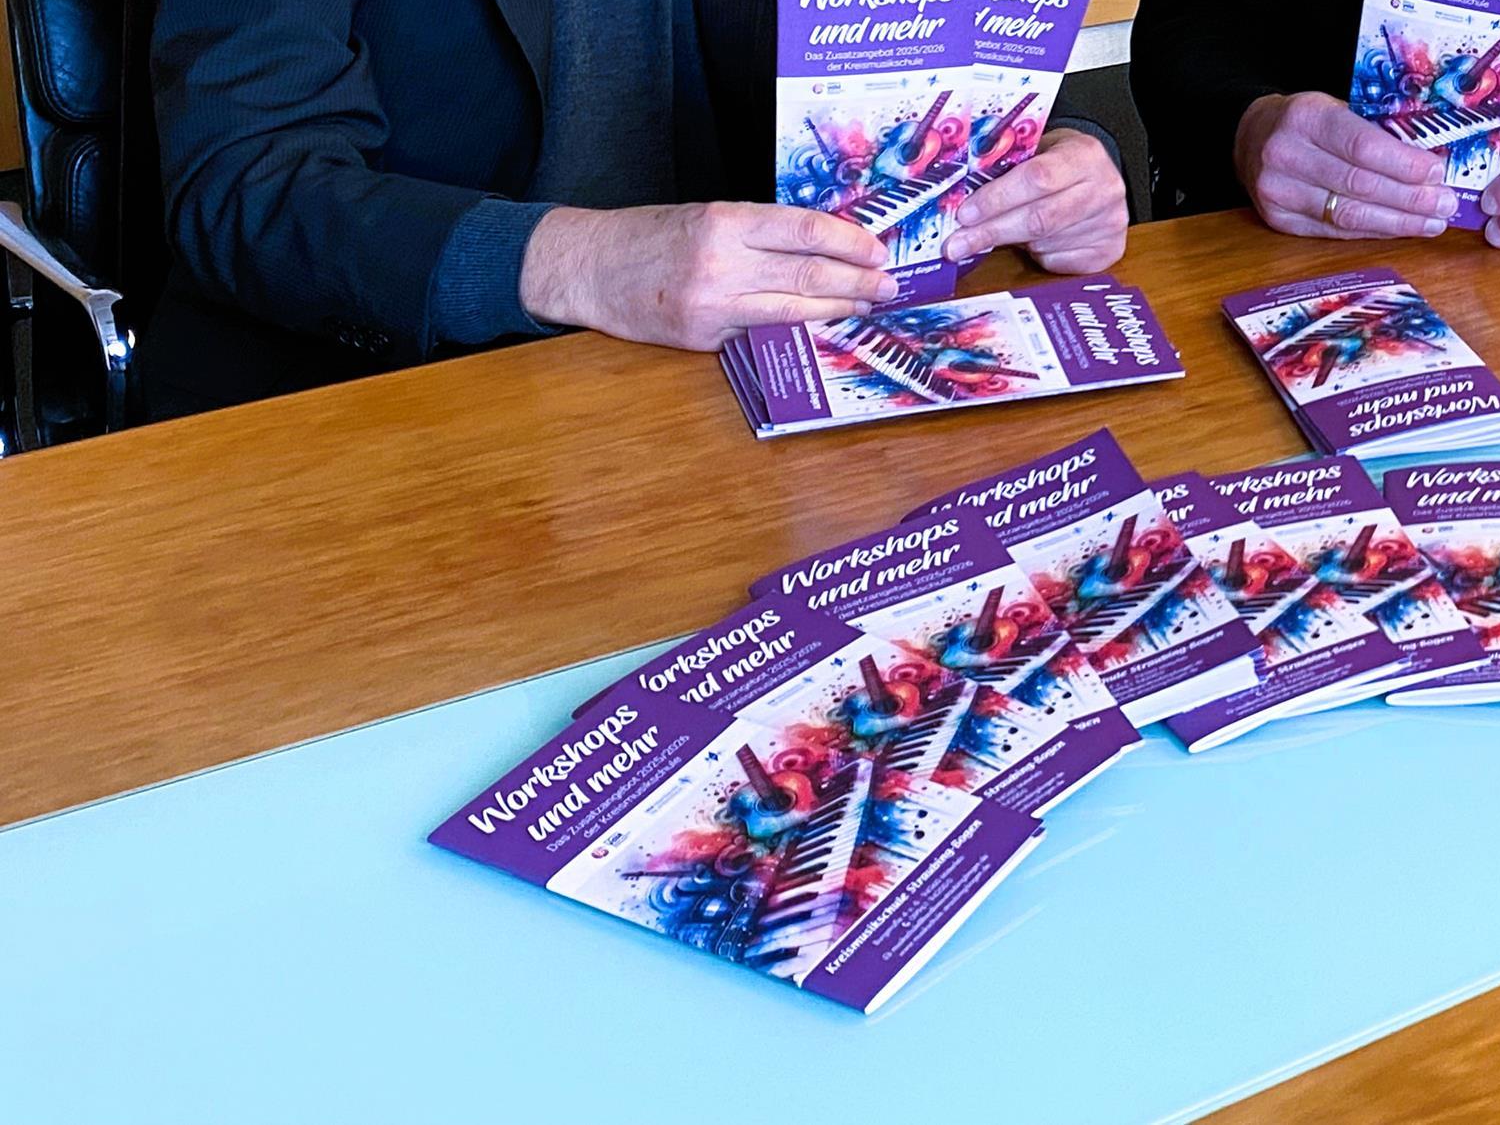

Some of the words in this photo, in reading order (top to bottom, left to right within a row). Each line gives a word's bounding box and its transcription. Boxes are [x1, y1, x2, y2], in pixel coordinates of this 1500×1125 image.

[809, 16, 870, 46] und
[869, 13, 946, 42] mehr
[982, 11, 1055, 40] mehr
[804, 52, 823, 62] Das
[824, 48, 894, 61] Zusatzangebot
[895, 44, 945, 57] 2025/2026
[826, 62, 842, 72] der
[843, 57, 924, 71] Kreismusikschule
[1001, 43, 1046, 56] 2025/2026
[1070, 302, 1107, 328] und
[1104, 294, 1160, 365] Workshops
[1082, 328, 1119, 365] mehr
[1348, 390, 1418, 418] mehr
[1424, 380, 1474, 402] und
[1348, 395, 1500, 437] Workshops
[1019, 474, 1098, 518] mehr
[1263, 485, 1341, 511] mehr
[1417, 486, 1481, 507] und
[782, 517, 960, 596] Workshops
[807, 571, 871, 611] und
[876, 544, 960, 585] mehr
[639, 609, 781, 692] orkshops
[722, 630, 795, 683] mehr
[468, 705, 638, 834] Workshops
[527, 783, 591, 842] und
[586, 725, 658, 793] mehr
[546, 834, 571, 852] Das
[567, 777, 640, 835] Zusatzangebot
[637, 735, 690, 778] 2025/2026
[584, 823, 600, 838] der
[599, 756, 682, 824] Kreismusikschule
[825, 892, 910, 975] Kreismusikschule
[905, 819, 983, 895] Straubing-Bogen
